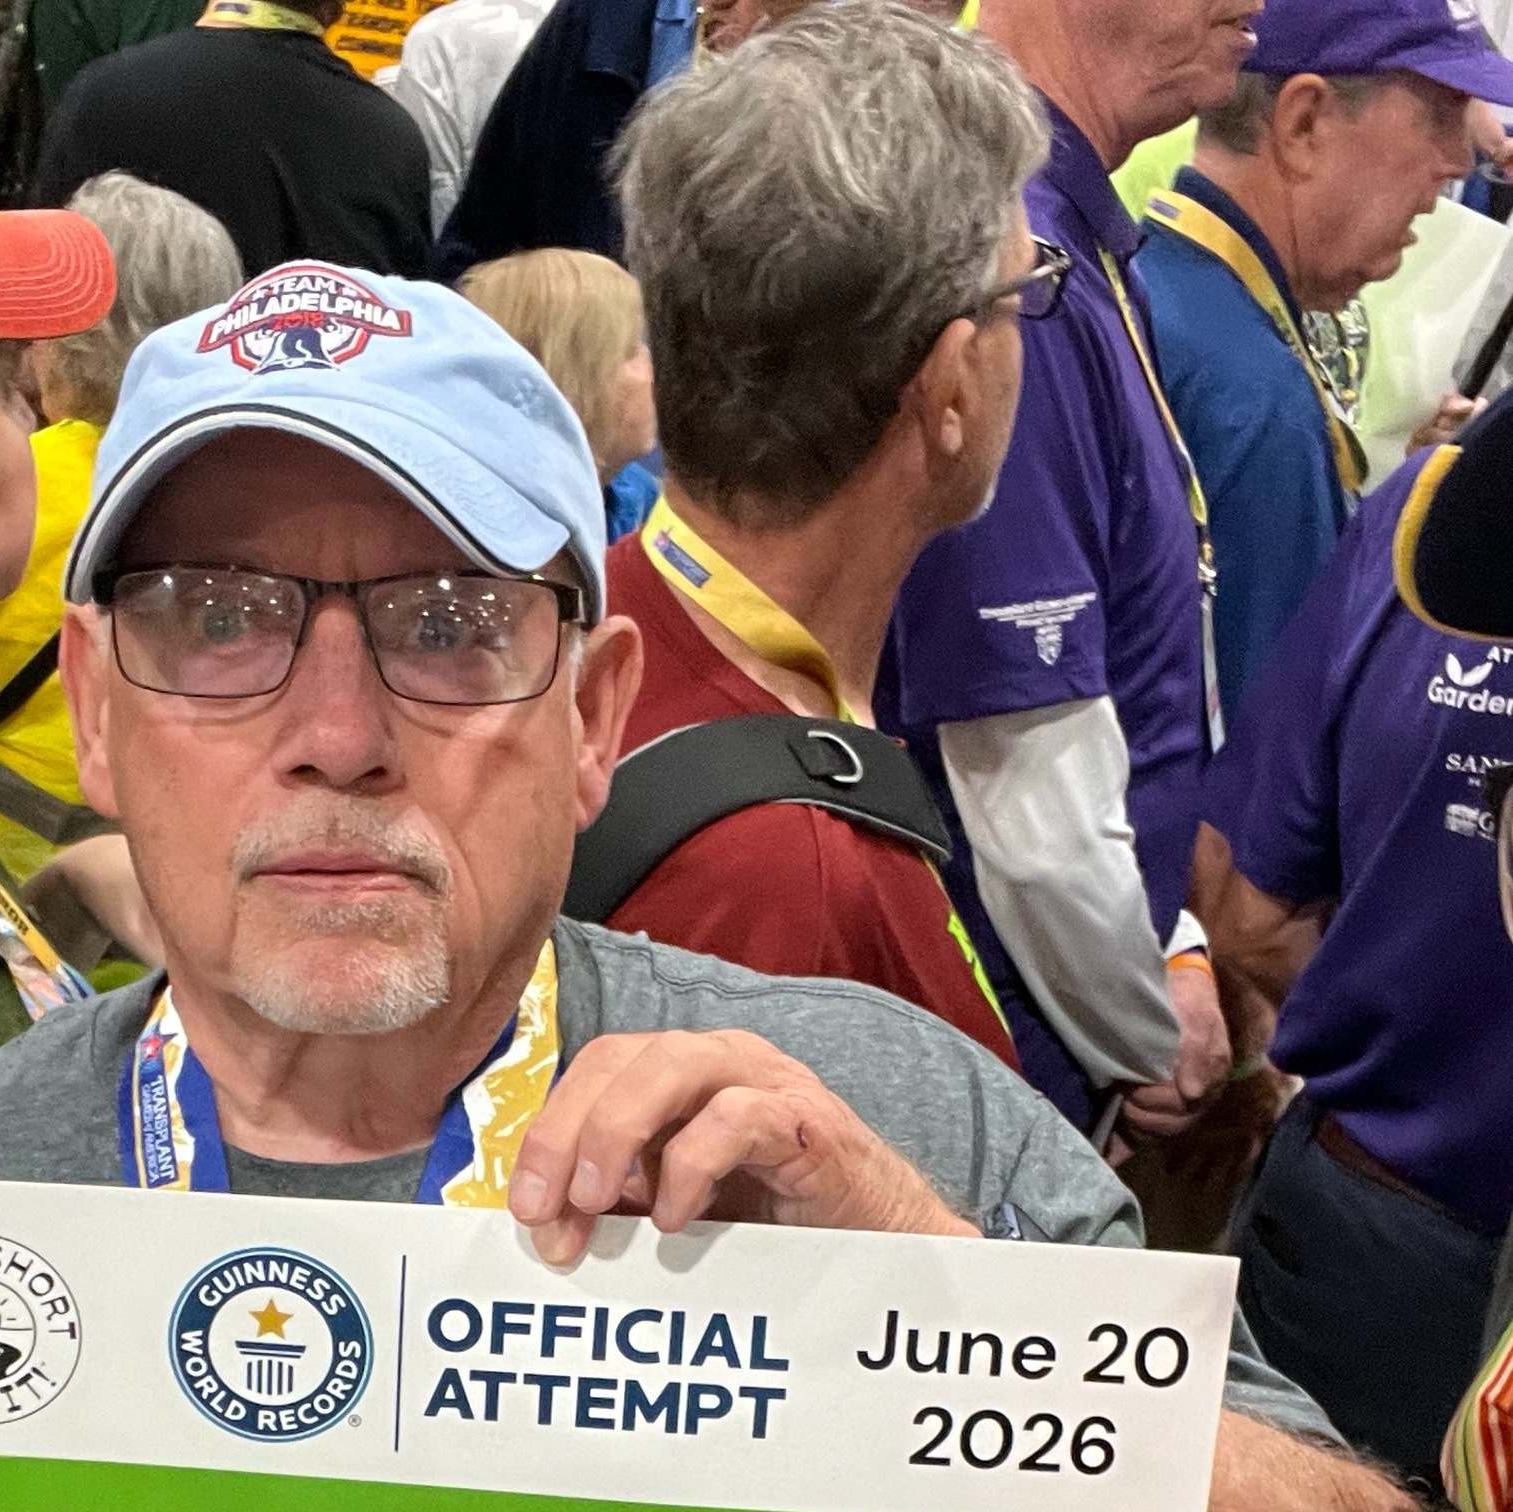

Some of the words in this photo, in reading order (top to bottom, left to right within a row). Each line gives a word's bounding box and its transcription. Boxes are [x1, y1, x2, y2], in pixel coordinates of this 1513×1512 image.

[210, 293, 401, 344] PHILADELPHIA
[271, 276, 339, 294] TEAM
[150, 1075, 176, 1180] TRANSPLANT
[198, 1260, 346, 1317] GUINNESS
[427, 1297, 789, 1372] OFFICIAL
[856, 1310, 1057, 1380] June
[1082, 1322, 1189, 1388] 20
[181, 1329, 244, 1422] WORLD
[259, 1338, 361, 1432] RECORDS
[423, 1367, 787, 1440] ATTEMPT
[908, 1406, 1118, 1476] 2026
